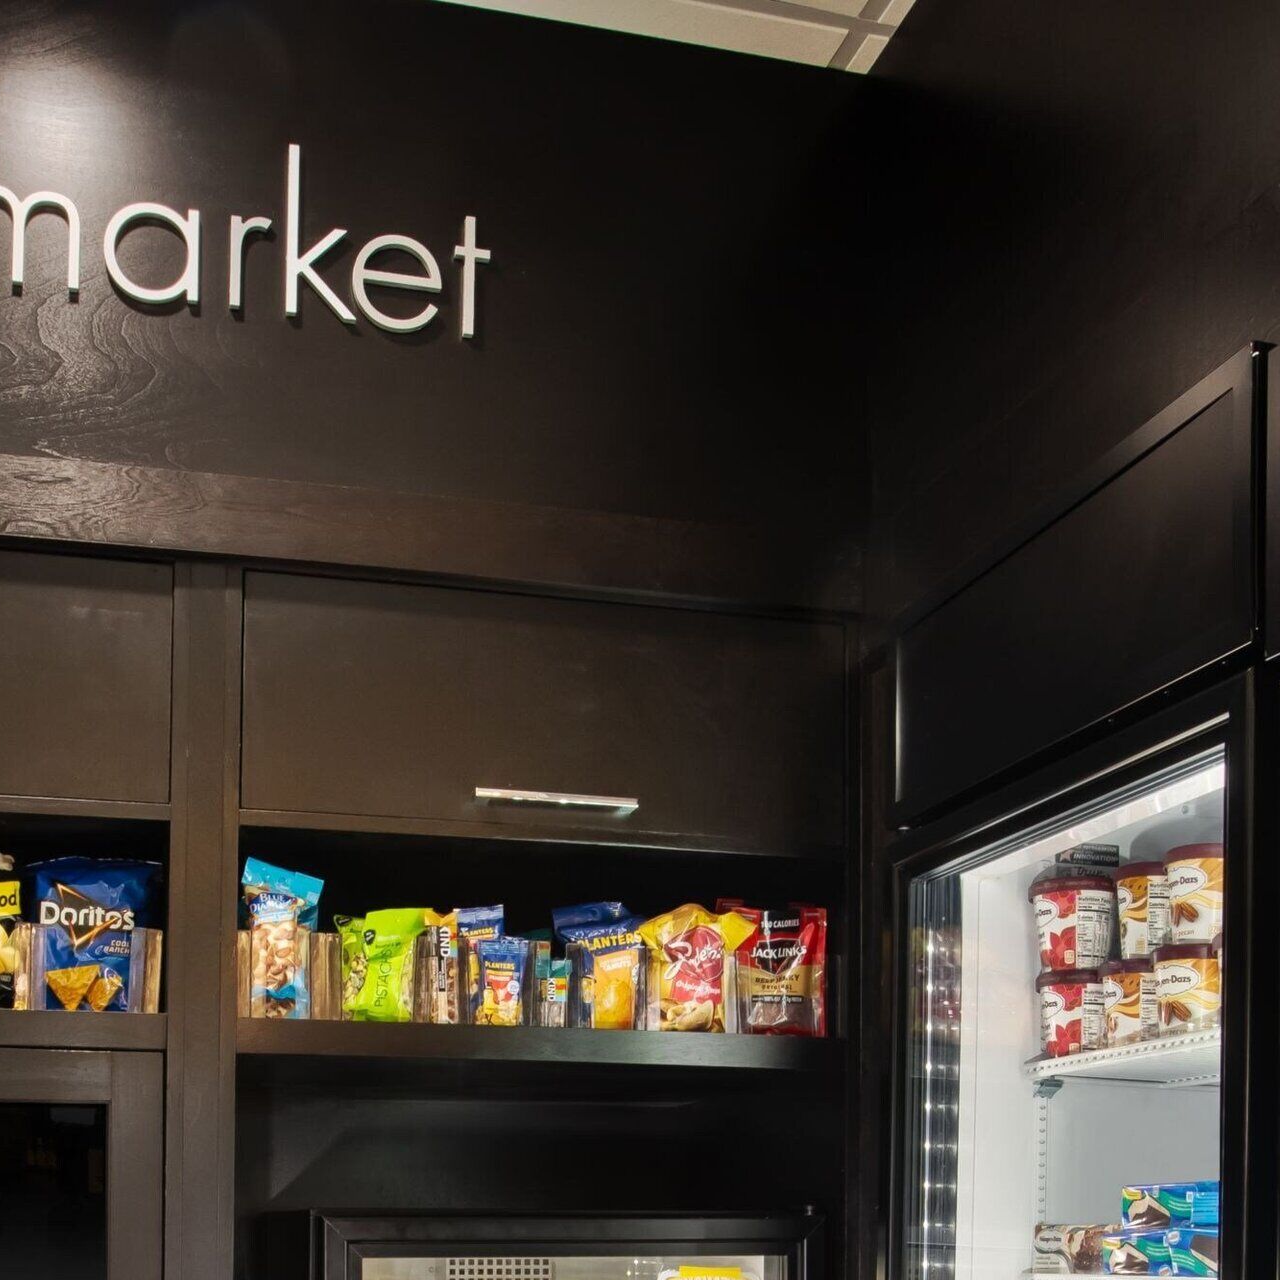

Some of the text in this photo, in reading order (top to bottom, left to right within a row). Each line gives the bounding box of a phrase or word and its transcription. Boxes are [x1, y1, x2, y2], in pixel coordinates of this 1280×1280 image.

[40, 901, 135, 931] Doritos
[773, 918, 800, 929] CALORIES
[750, 946, 777, 959] JACK
[484, 960, 516, 970] PLANTERS
